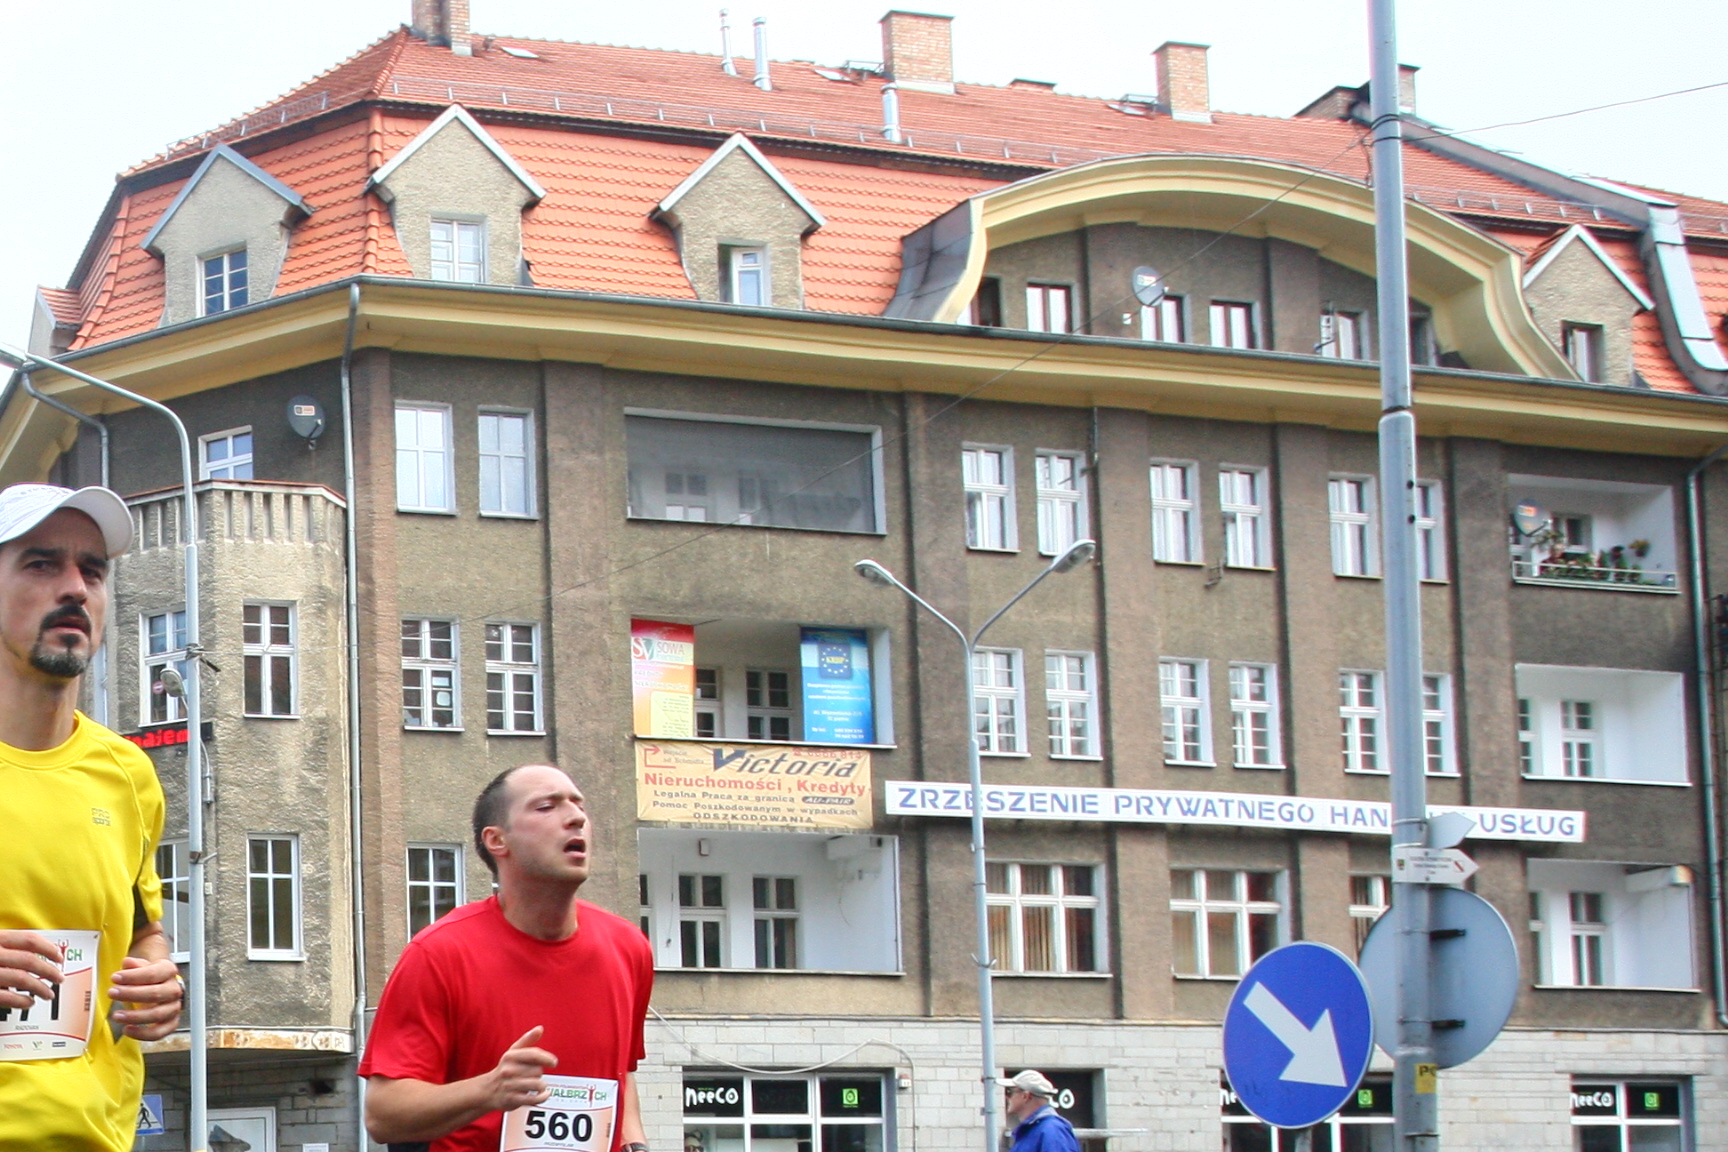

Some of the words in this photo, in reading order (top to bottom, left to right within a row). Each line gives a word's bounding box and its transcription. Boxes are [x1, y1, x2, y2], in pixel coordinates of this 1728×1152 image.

[656, 641, 685, 655] SOWA
[712, 748, 858, 778] Victoria
[644, 773, 782, 791] Nieruchomości
[797, 779, 866, 797] Kredyty
[654, 790, 697, 799] Legalna
[702, 791, 733, 800] Praca
[652, 800, 688, 809] Pomoc
[694, 802, 781, 813] Poszkodowanym
[800, 806, 858, 816] wypadkach
[693, 812, 814, 824] ODSZKODOWANIA
[1114, 794, 1314, 823] PRYWATNEGO
[1479, 813, 1576, 837] USŁUG
[524, 1110, 593, 1142] 560
